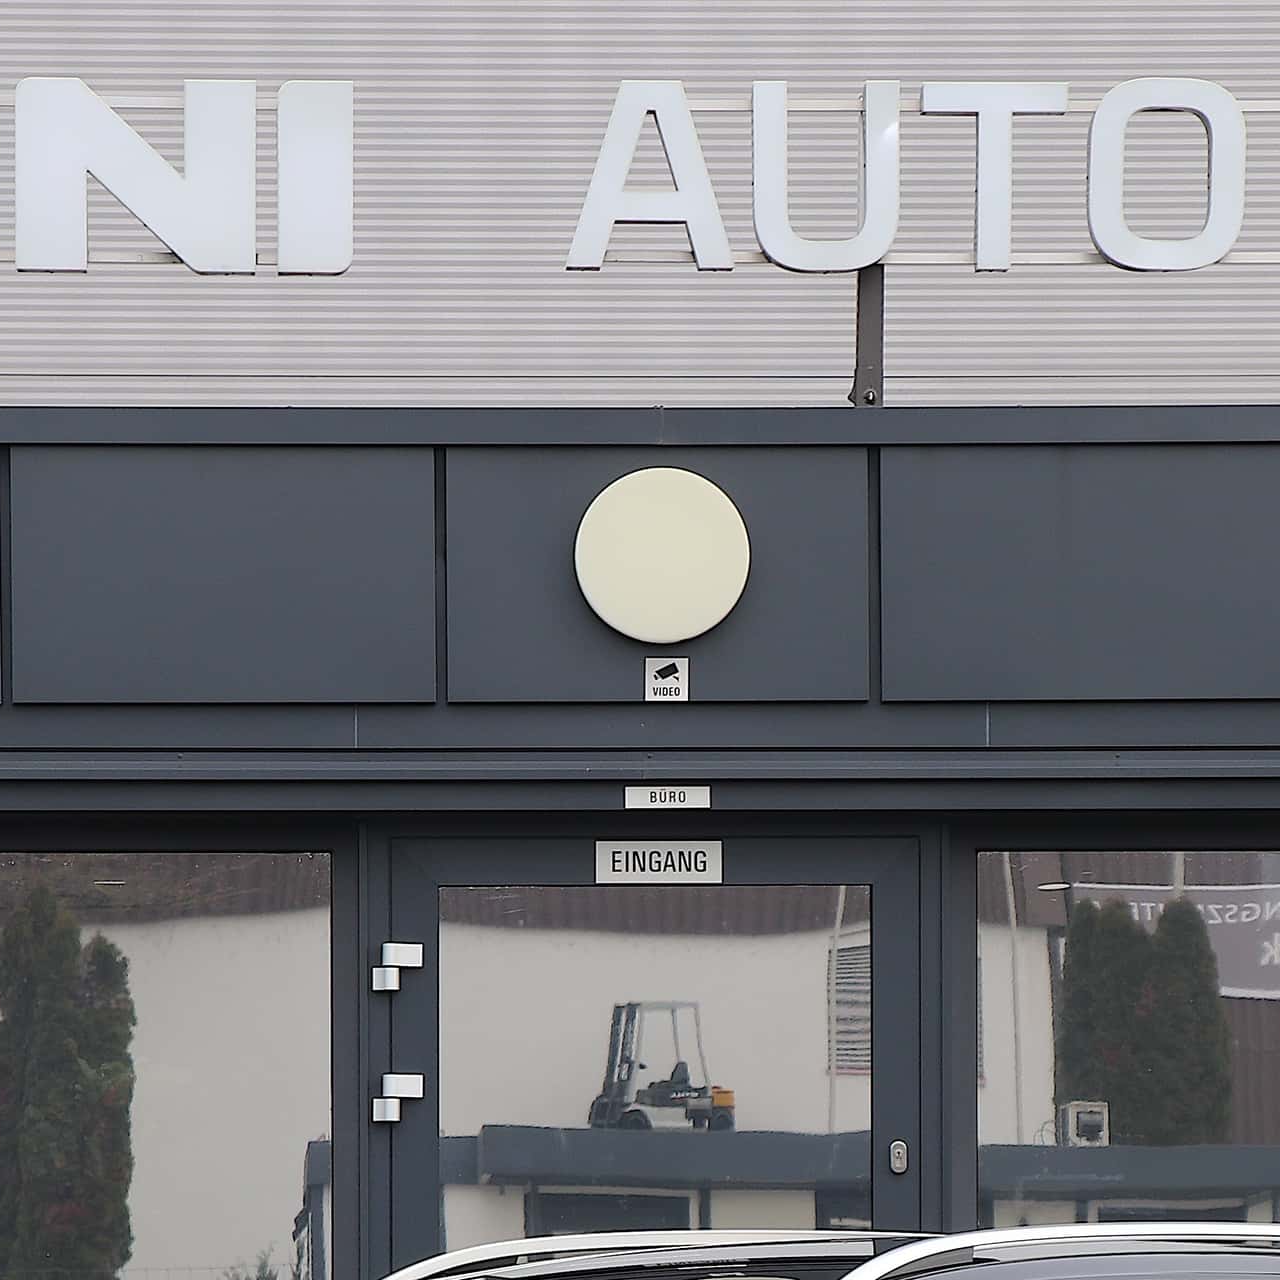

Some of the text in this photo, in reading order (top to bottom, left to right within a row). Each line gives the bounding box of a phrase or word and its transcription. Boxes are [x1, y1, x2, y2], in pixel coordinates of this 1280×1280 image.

[566, 77, 1247, 272] AUTO
[652, 686, 681, 697] VIDEO
[649, 788, 687, 804] BÜRO
[611, 850, 708, 873] EINGANG
